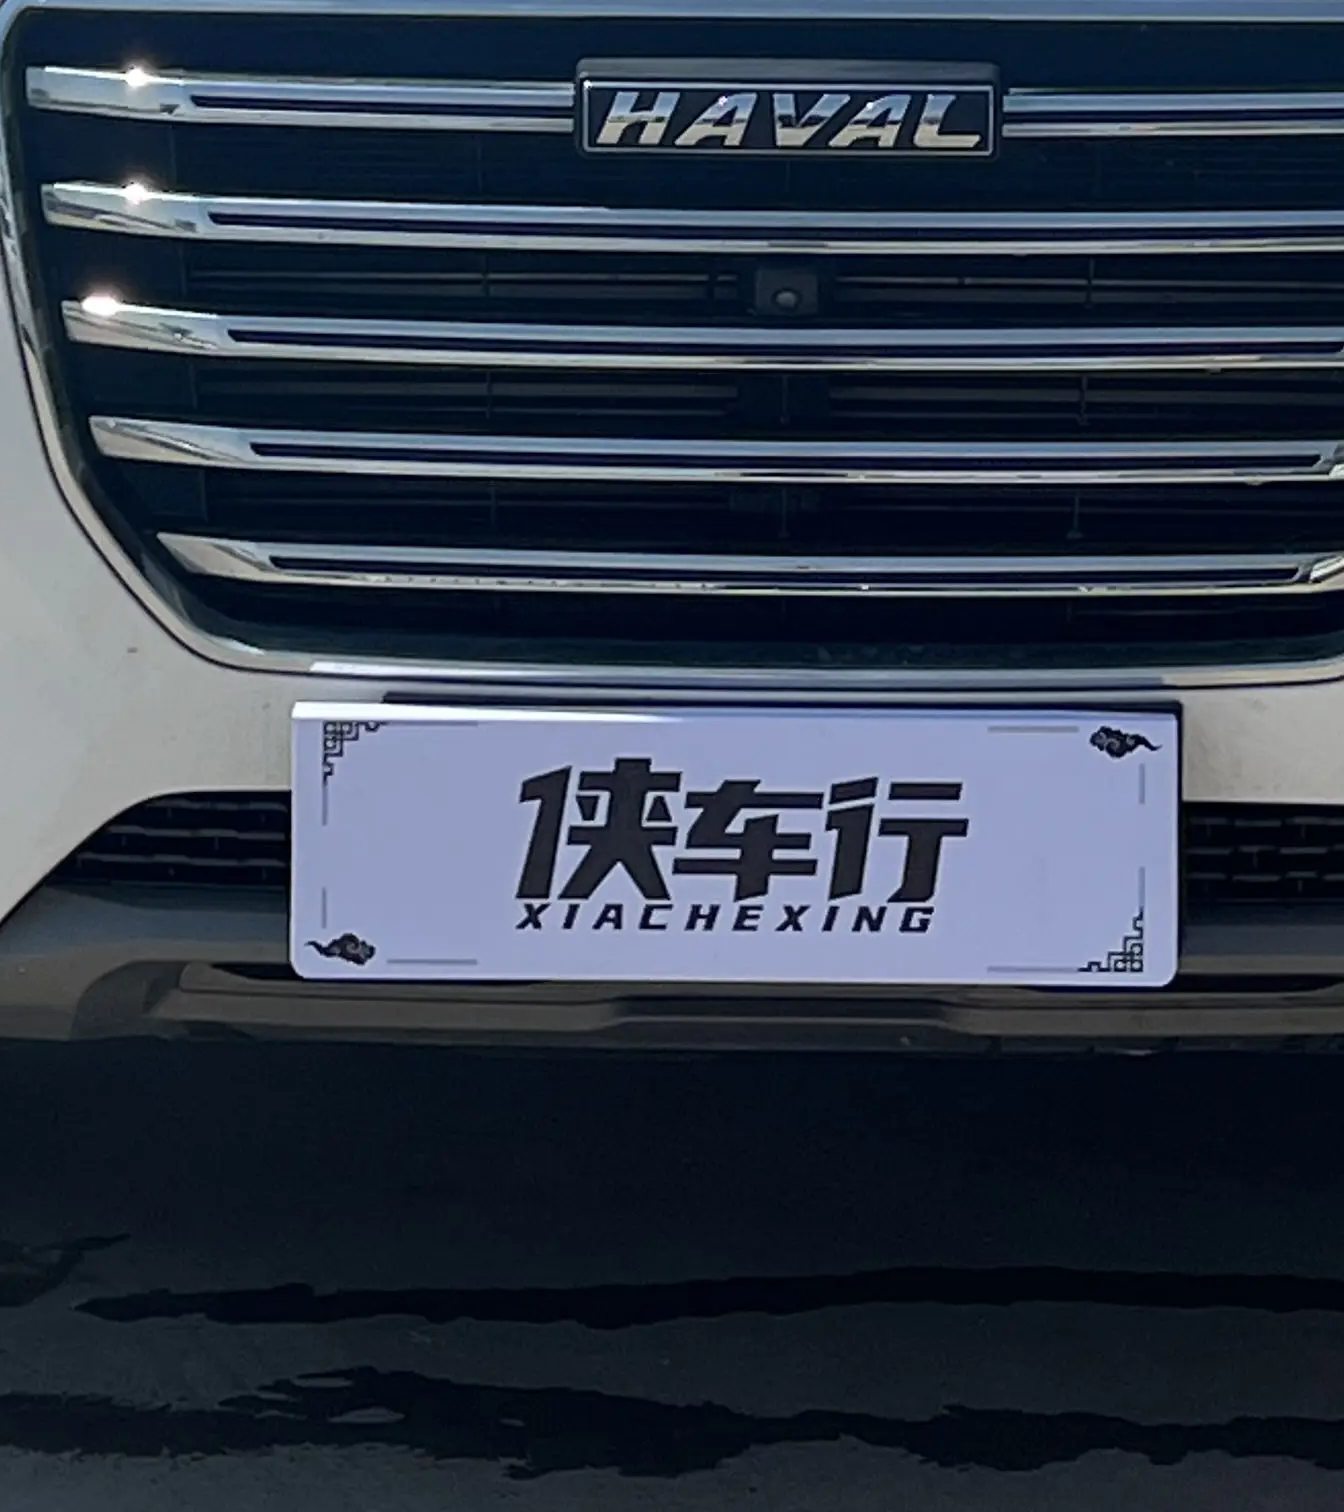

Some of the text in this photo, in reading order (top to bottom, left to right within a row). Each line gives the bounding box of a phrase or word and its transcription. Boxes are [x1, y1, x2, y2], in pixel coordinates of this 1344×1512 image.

[596, 91, 981, 148] HAVAL
[515, 757, 969, 903] 侠车行
[515, 903, 935, 933] XIACHEXING
